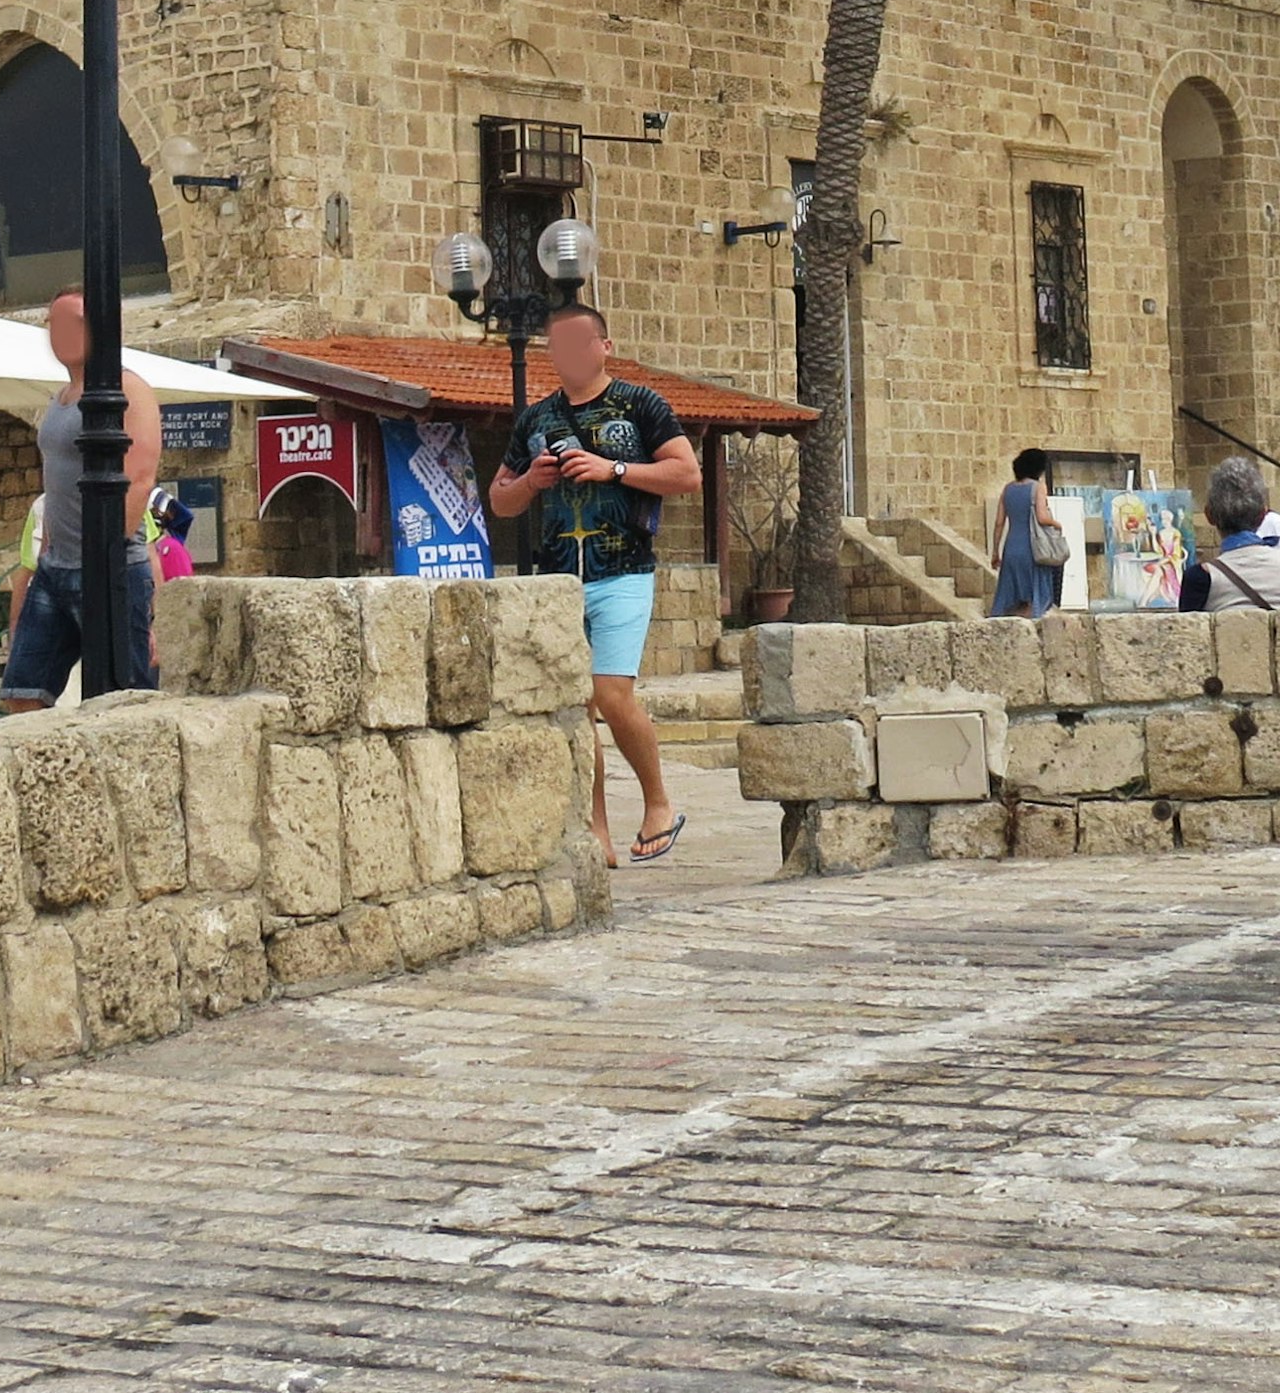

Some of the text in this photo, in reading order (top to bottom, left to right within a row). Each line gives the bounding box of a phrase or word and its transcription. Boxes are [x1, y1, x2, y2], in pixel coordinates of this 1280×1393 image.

[167, 413, 183, 421] THE
[186, 411, 209, 421] PORT
[210, 412, 229, 420] AND
[275, 423, 333, 452] הכיכר
[279, 449, 333, 464] theatre.cafe
[417, 543, 482, 565] בתים
